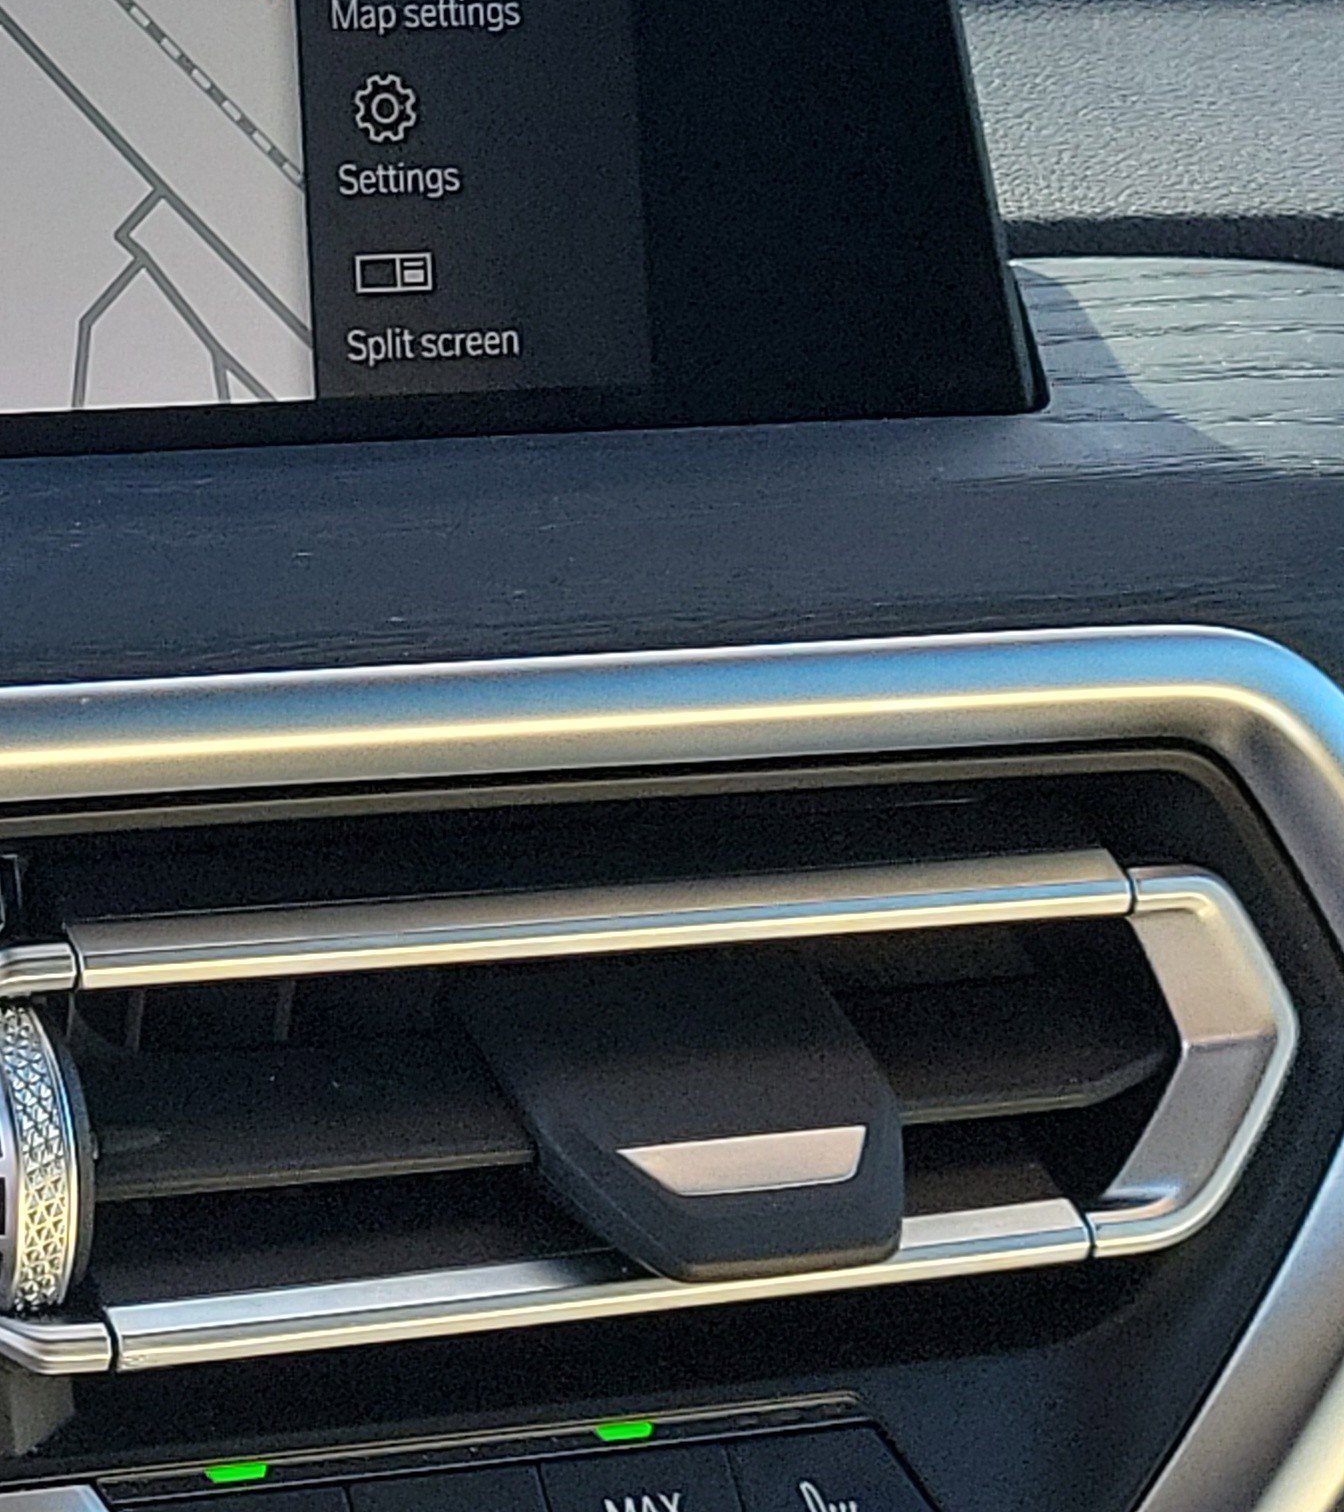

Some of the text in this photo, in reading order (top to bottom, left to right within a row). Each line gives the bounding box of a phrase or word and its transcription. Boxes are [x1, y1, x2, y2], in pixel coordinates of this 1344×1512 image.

[338, 163, 461, 198] Settings
[347, 329, 520, 365] Split screen
